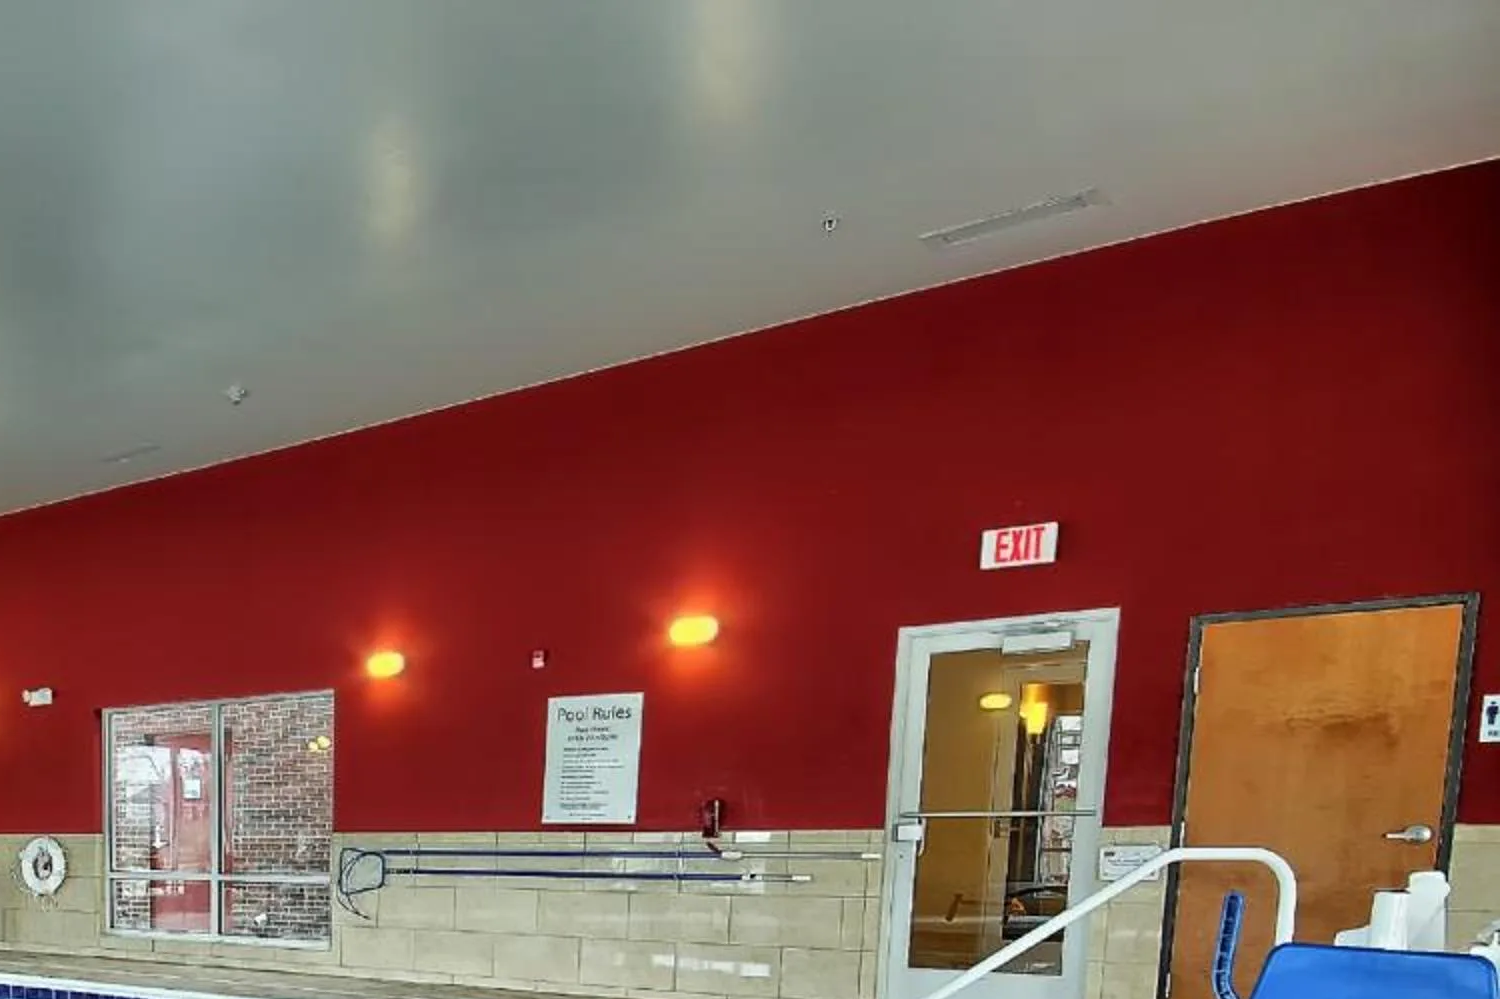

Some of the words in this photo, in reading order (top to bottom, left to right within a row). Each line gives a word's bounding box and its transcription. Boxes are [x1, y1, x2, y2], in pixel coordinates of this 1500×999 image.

[995, 526, 1045, 563] EXIT
[557, 706, 588, 721] Pool
[592, 705, 632, 720] Rules
